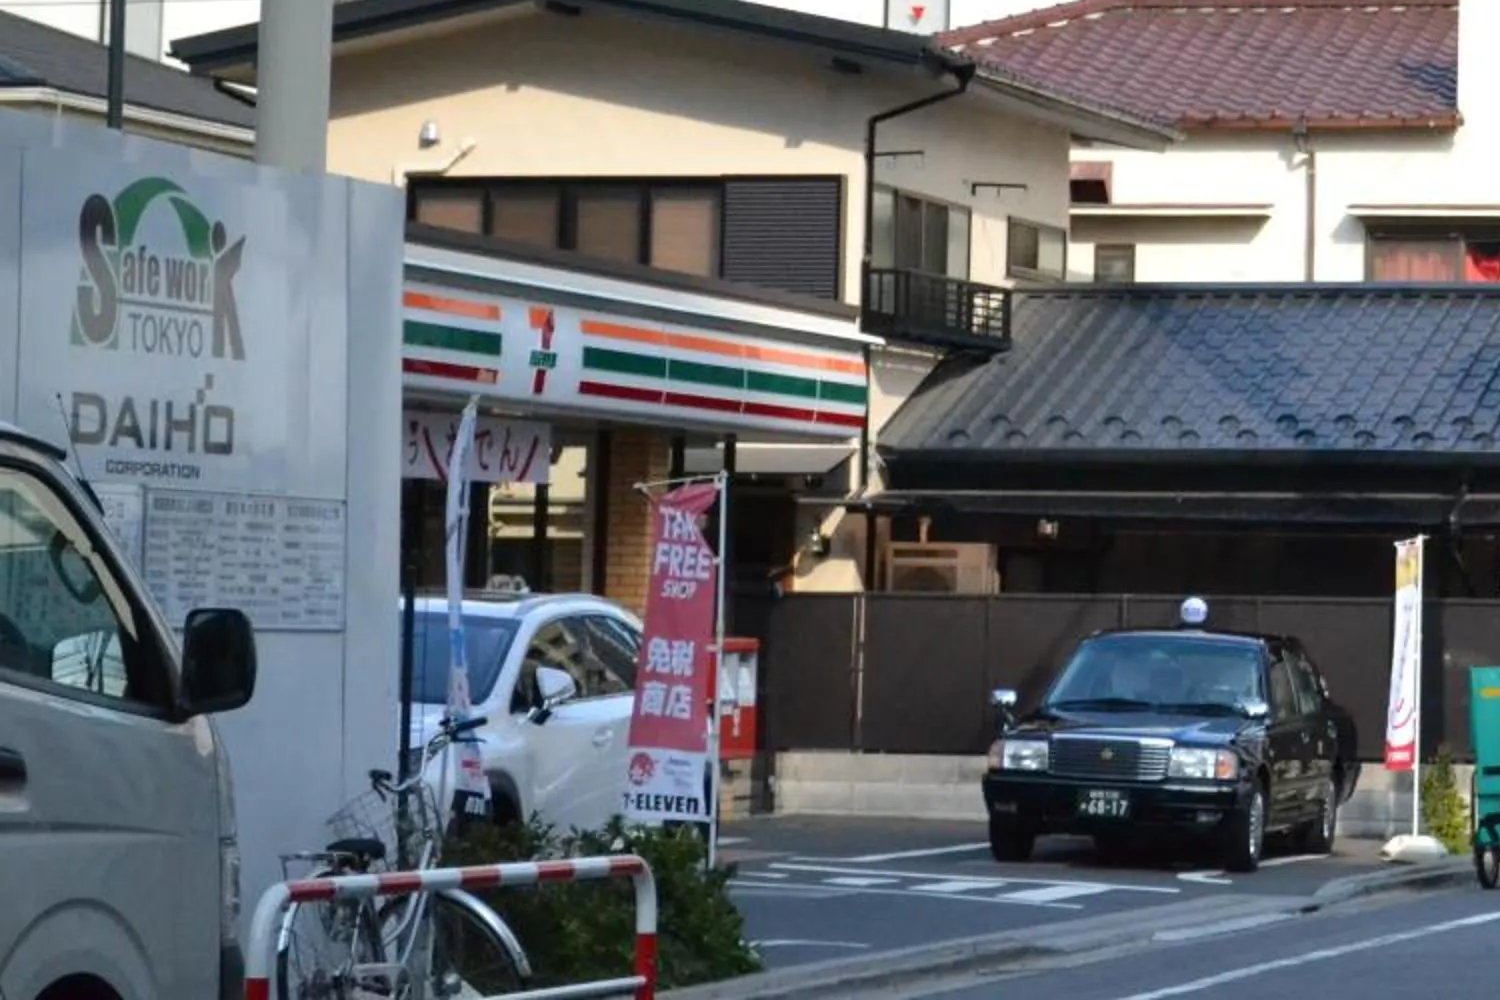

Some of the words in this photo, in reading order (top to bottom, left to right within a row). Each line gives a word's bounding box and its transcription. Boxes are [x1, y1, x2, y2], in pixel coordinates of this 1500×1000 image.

[128, 312, 203, 359] TOKYO
[105, 459, 200, 480] CORPORATION
[653, 541, 710, 580] FREE
